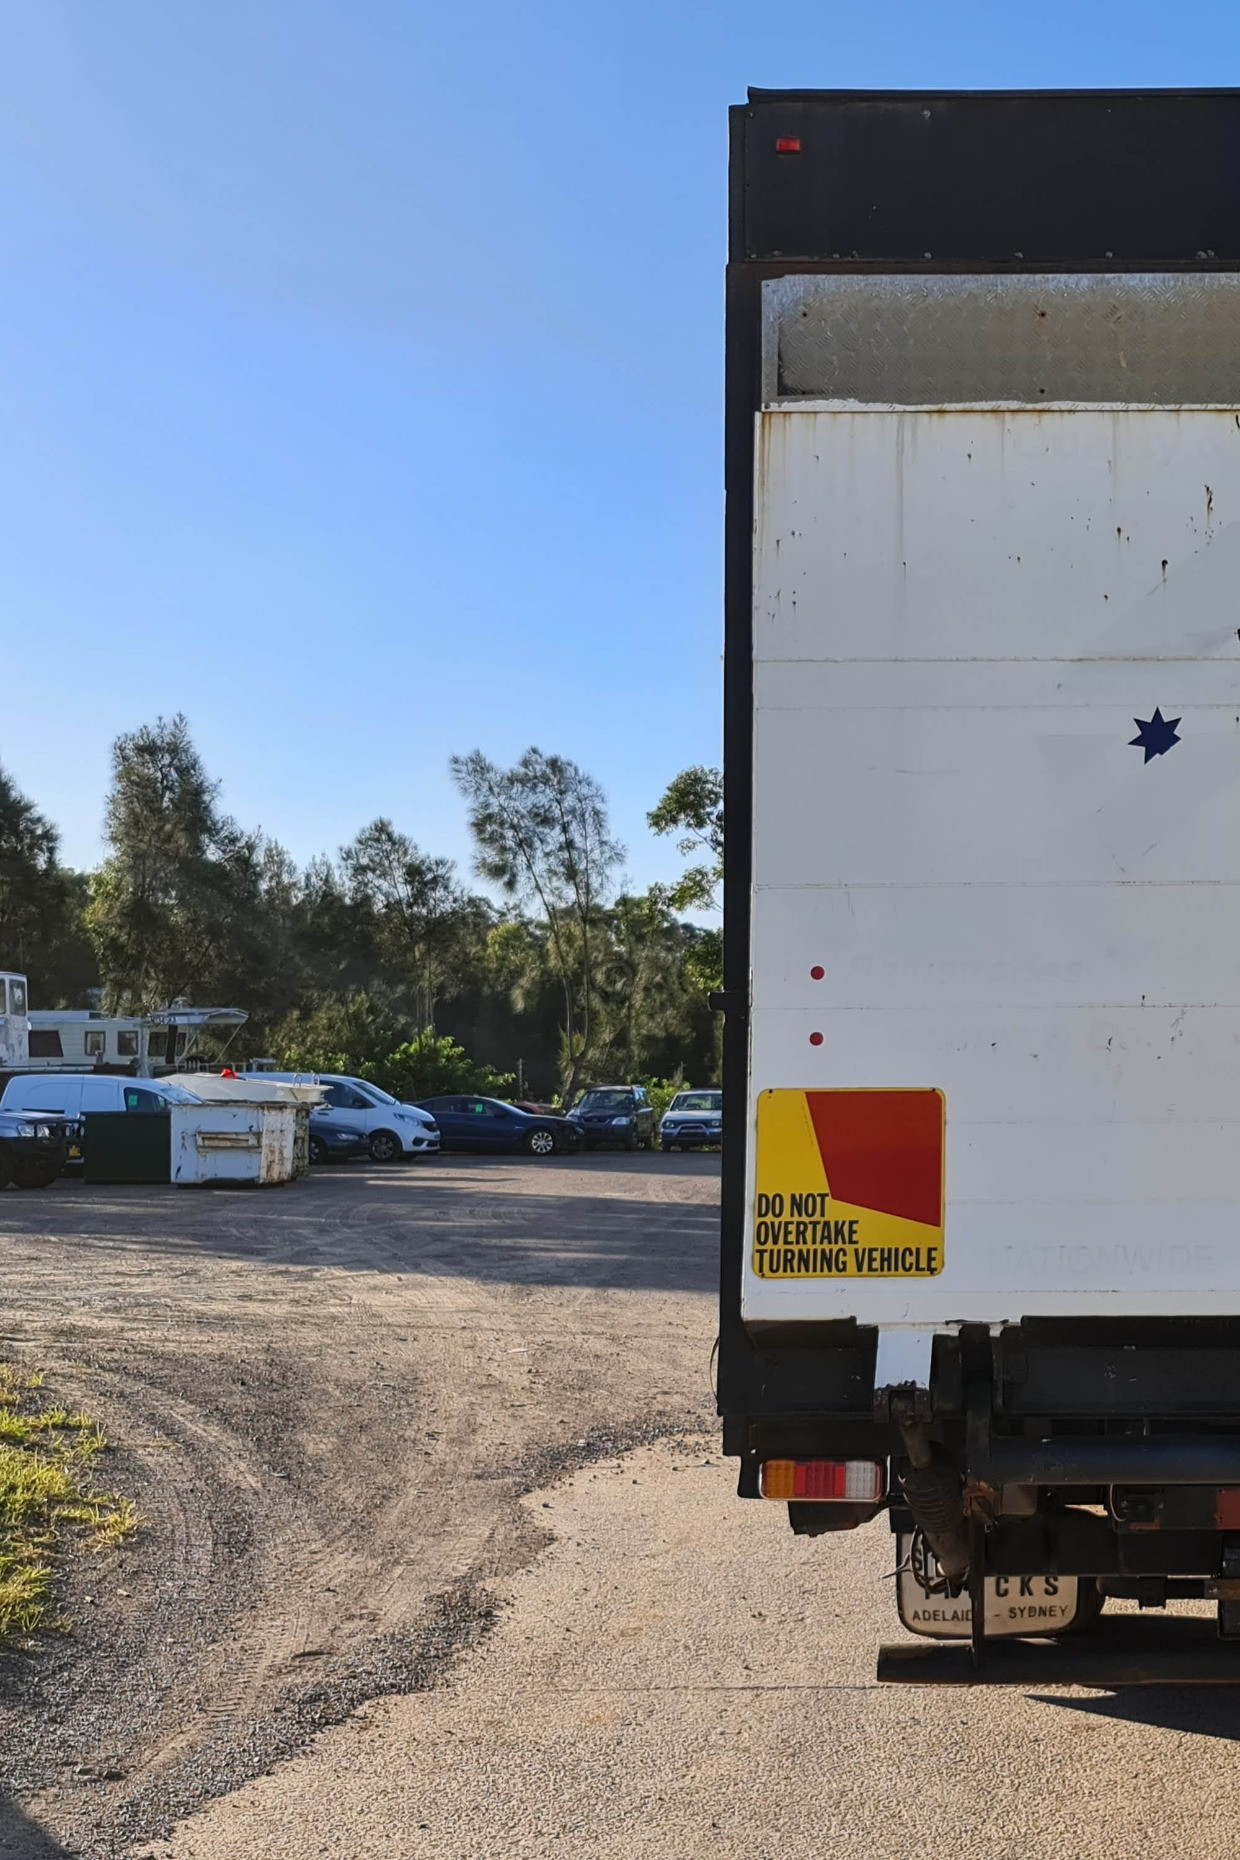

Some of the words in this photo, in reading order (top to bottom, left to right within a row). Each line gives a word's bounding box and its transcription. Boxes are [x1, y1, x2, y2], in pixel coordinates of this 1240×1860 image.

[757, 1192, 784, 1218] DO
[790, 1192, 829, 1218] NOT
[756, 1219, 859, 1245] OVERTAKE
[756, 1247, 848, 1274] TURNING
[854, 1247, 938, 1273] VEHICLE
[912, 1608, 974, 1622] ADELAID
[1009, 1605, 1069, 1619] SYDNEY
